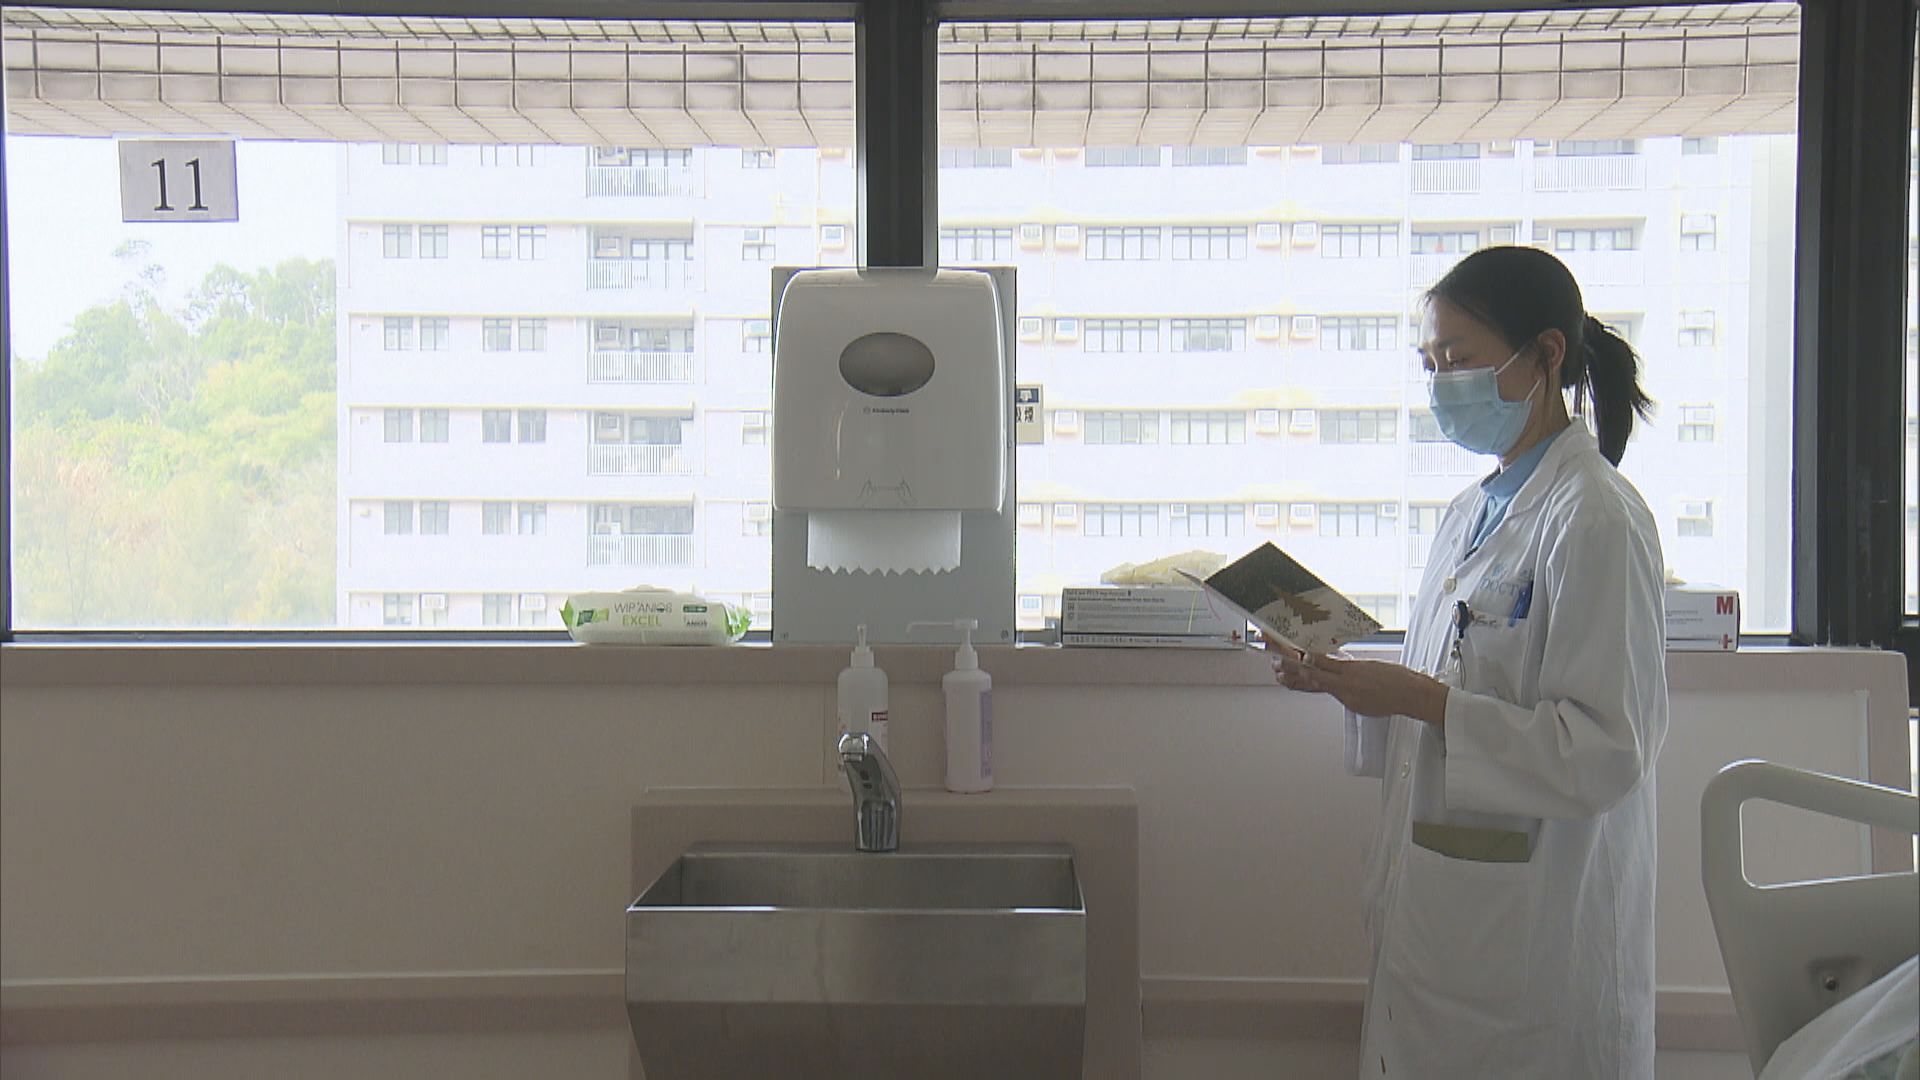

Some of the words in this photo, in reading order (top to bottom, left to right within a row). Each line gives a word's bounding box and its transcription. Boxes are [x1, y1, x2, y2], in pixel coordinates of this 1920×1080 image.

[151, 158, 209, 211] 11
[1479, 577, 1520, 597] DOCT
[1716, 596, 1734, 615] M
[622, 615, 662, 627] EXCEL
